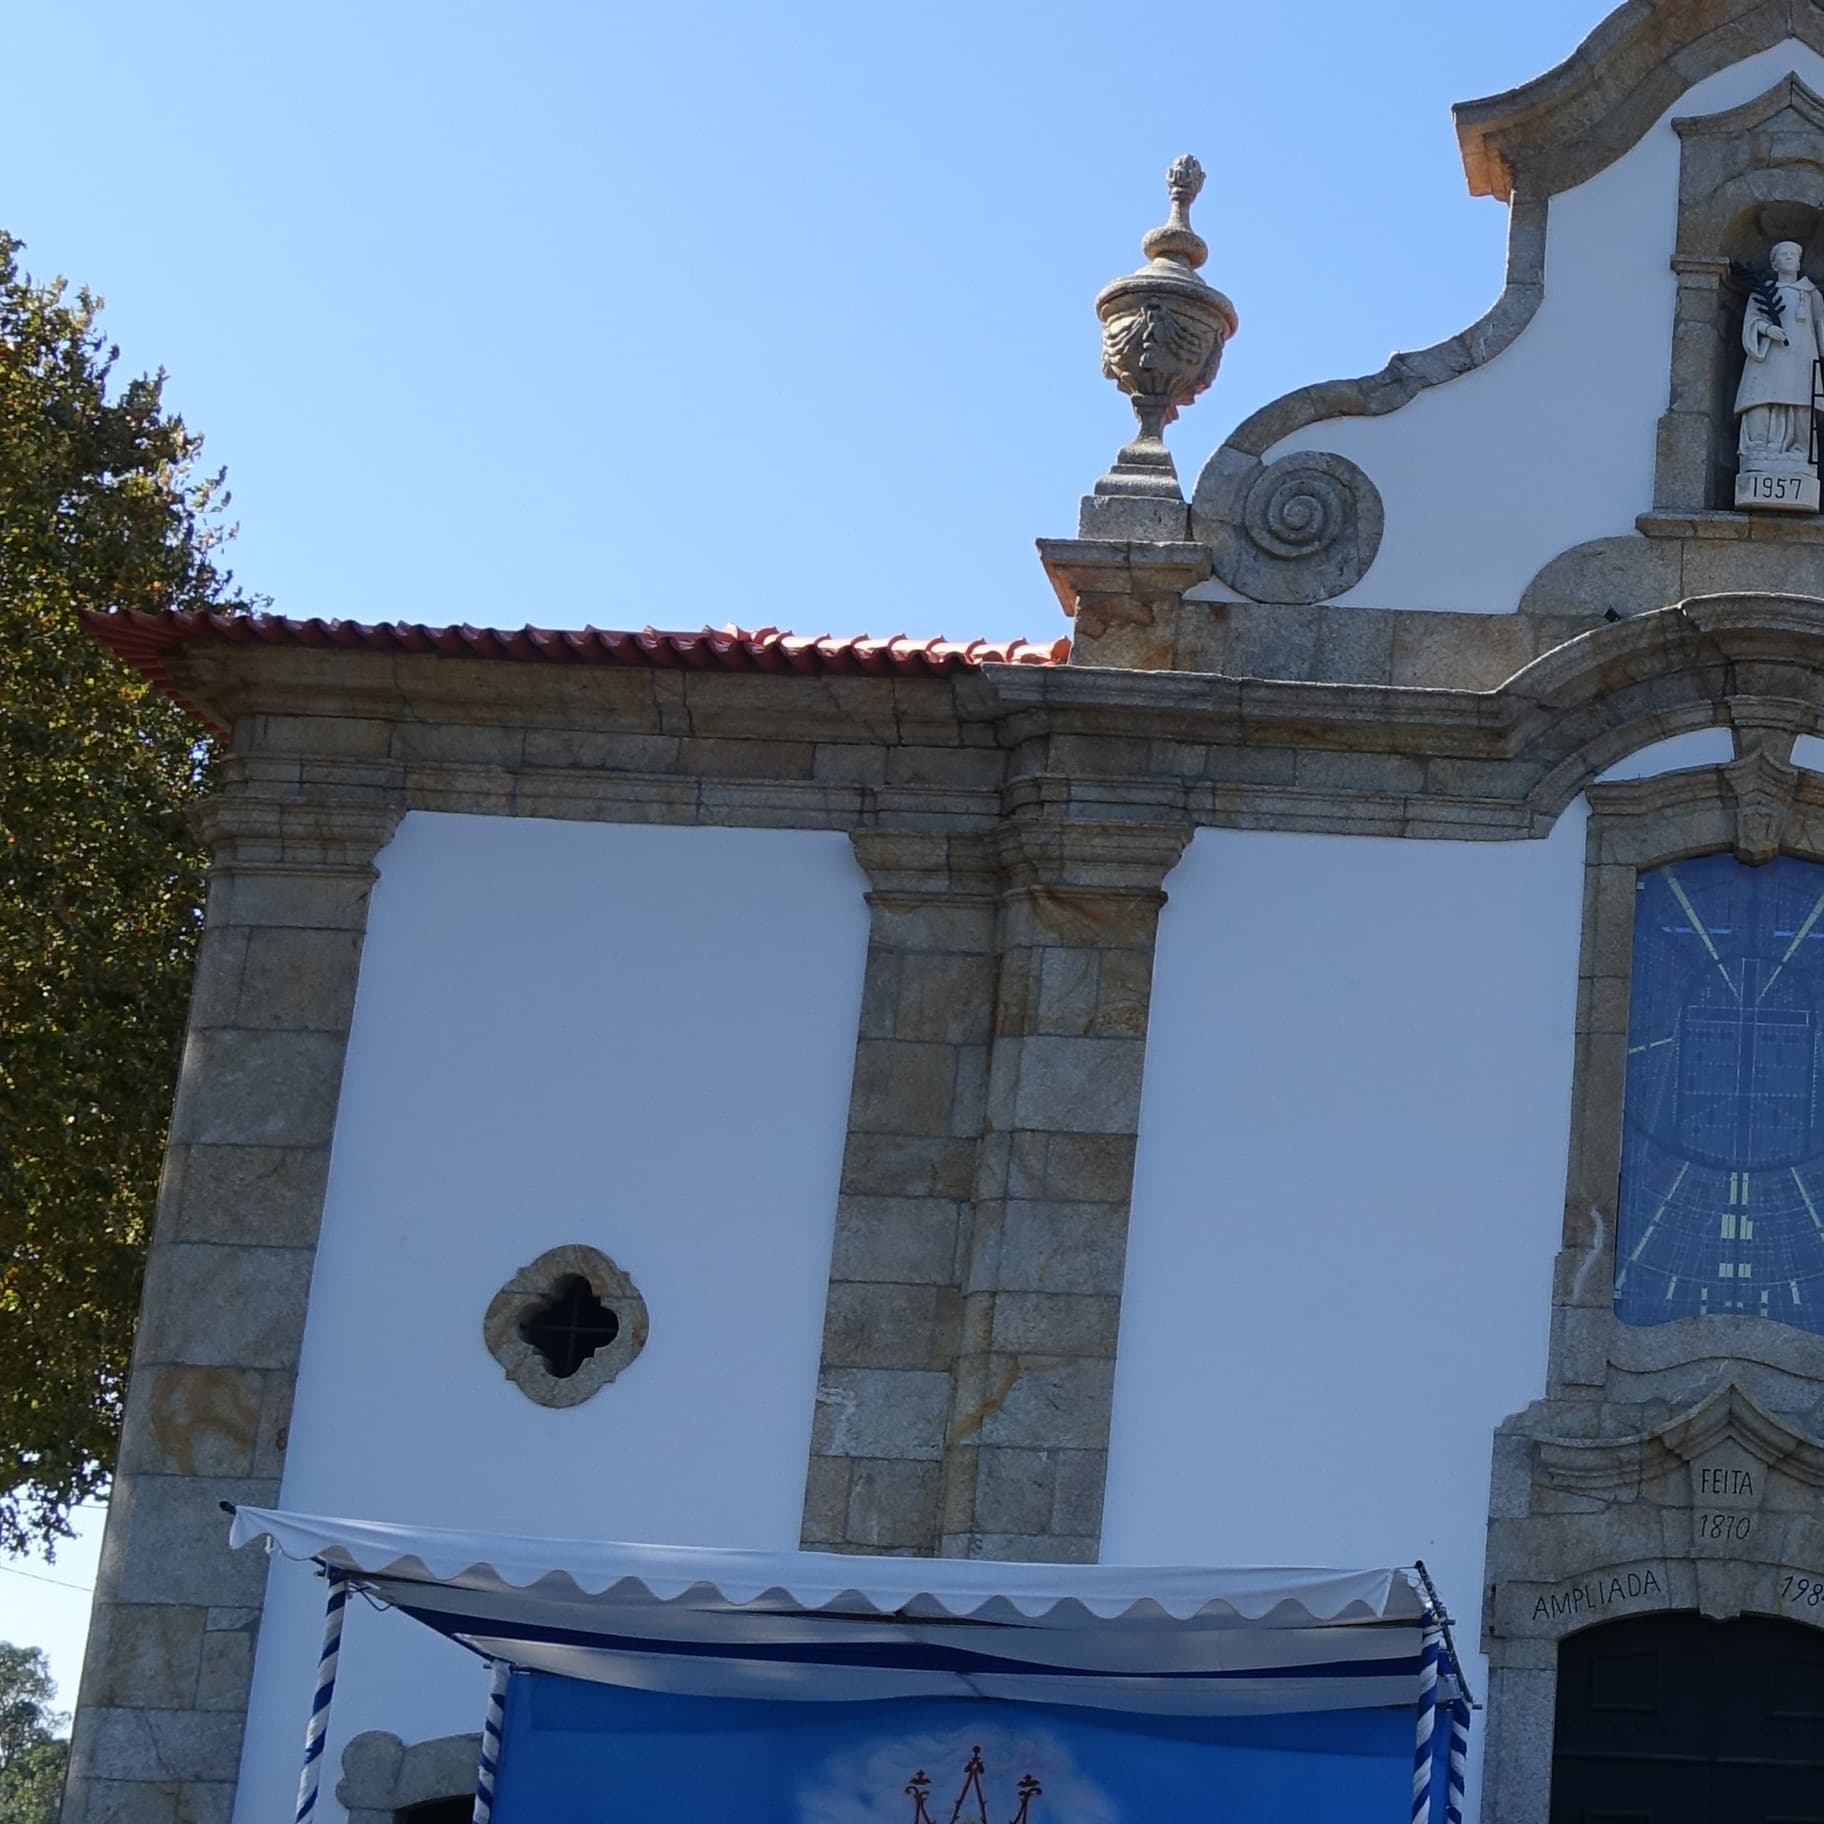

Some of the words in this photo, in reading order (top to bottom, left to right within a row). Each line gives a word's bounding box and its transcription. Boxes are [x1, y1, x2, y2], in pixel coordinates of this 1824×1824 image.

[1753, 477, 1802, 500] 1957
[1701, 1468, 1753, 1496] FEITA
[1700, 1514, 1751, 1542] 1870
[1532, 1569, 1662, 1621] AMPLIADA
